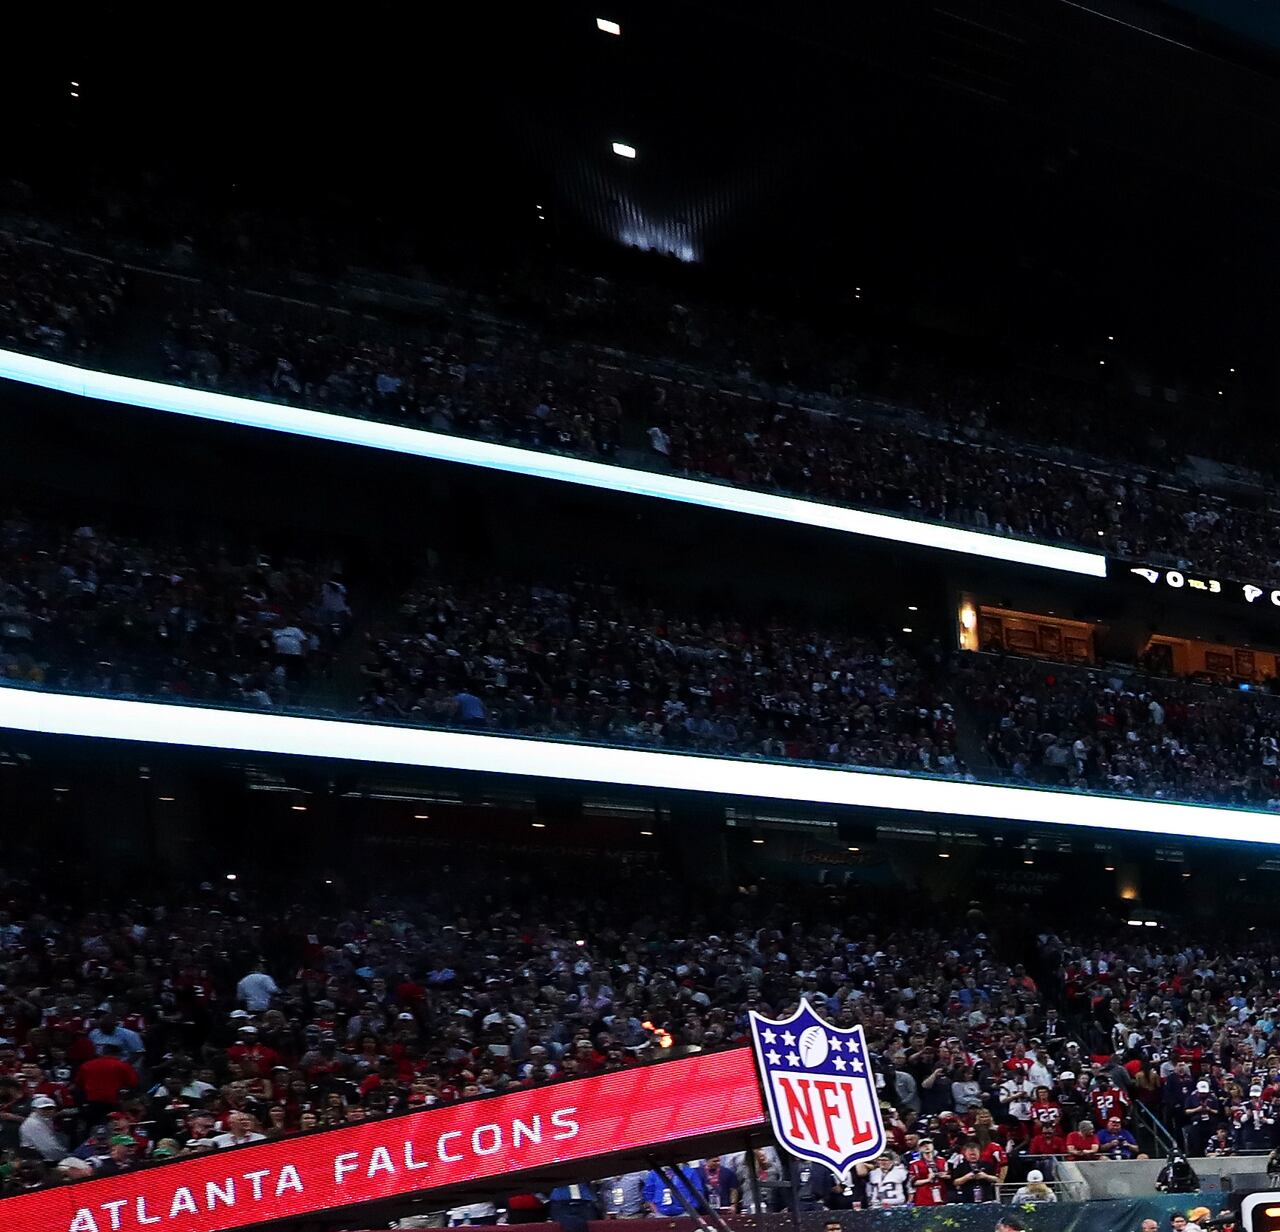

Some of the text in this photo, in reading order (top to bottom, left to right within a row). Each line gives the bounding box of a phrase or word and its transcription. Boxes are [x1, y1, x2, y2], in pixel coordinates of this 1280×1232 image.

[778, 1077, 873, 1153] NFL
[1037, 1107, 1059, 1123] 22
[1096, 1095, 1114, 1109] 22
[333, 1106, 581, 1185] FALCONS
